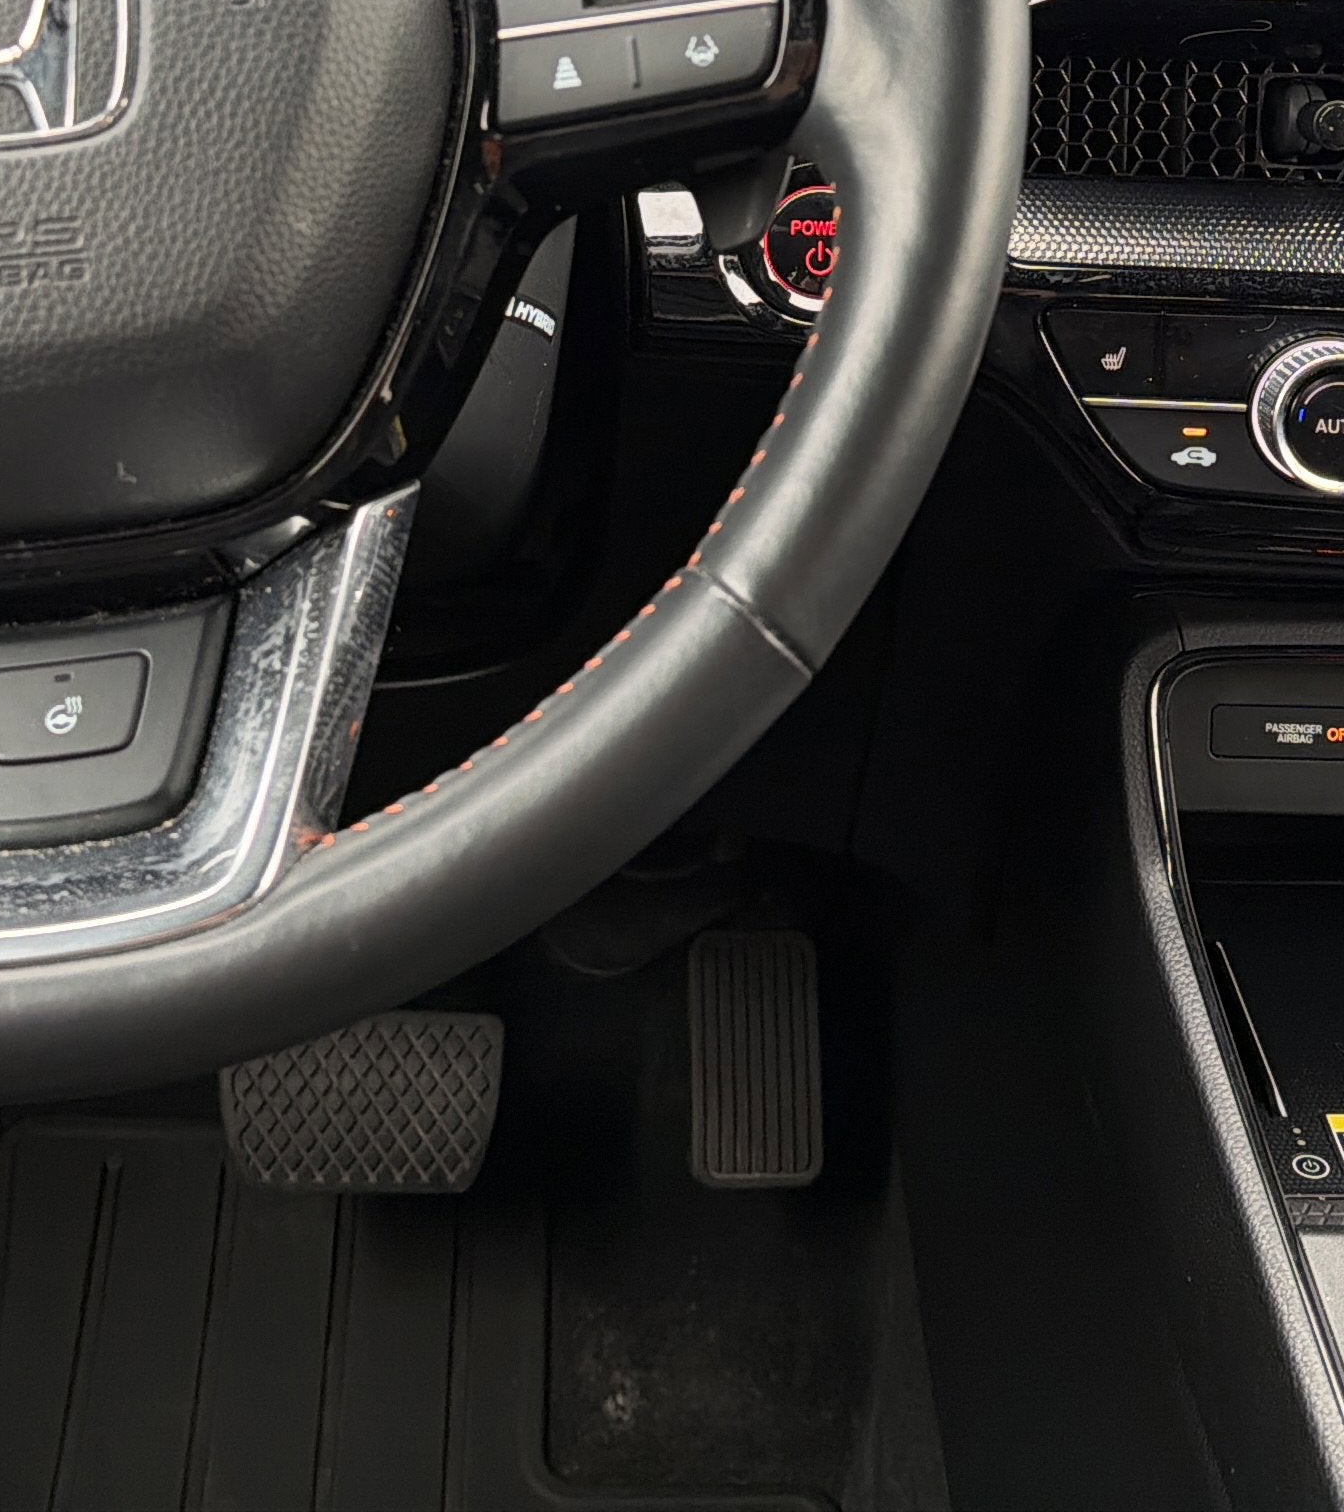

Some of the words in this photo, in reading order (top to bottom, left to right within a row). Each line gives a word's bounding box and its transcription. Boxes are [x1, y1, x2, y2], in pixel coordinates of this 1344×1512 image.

[790, 219, 837, 236] POWE
[1265, 722, 1323, 734] PASSENGER
[1277, 734, 1314, 744] AIRBAG
